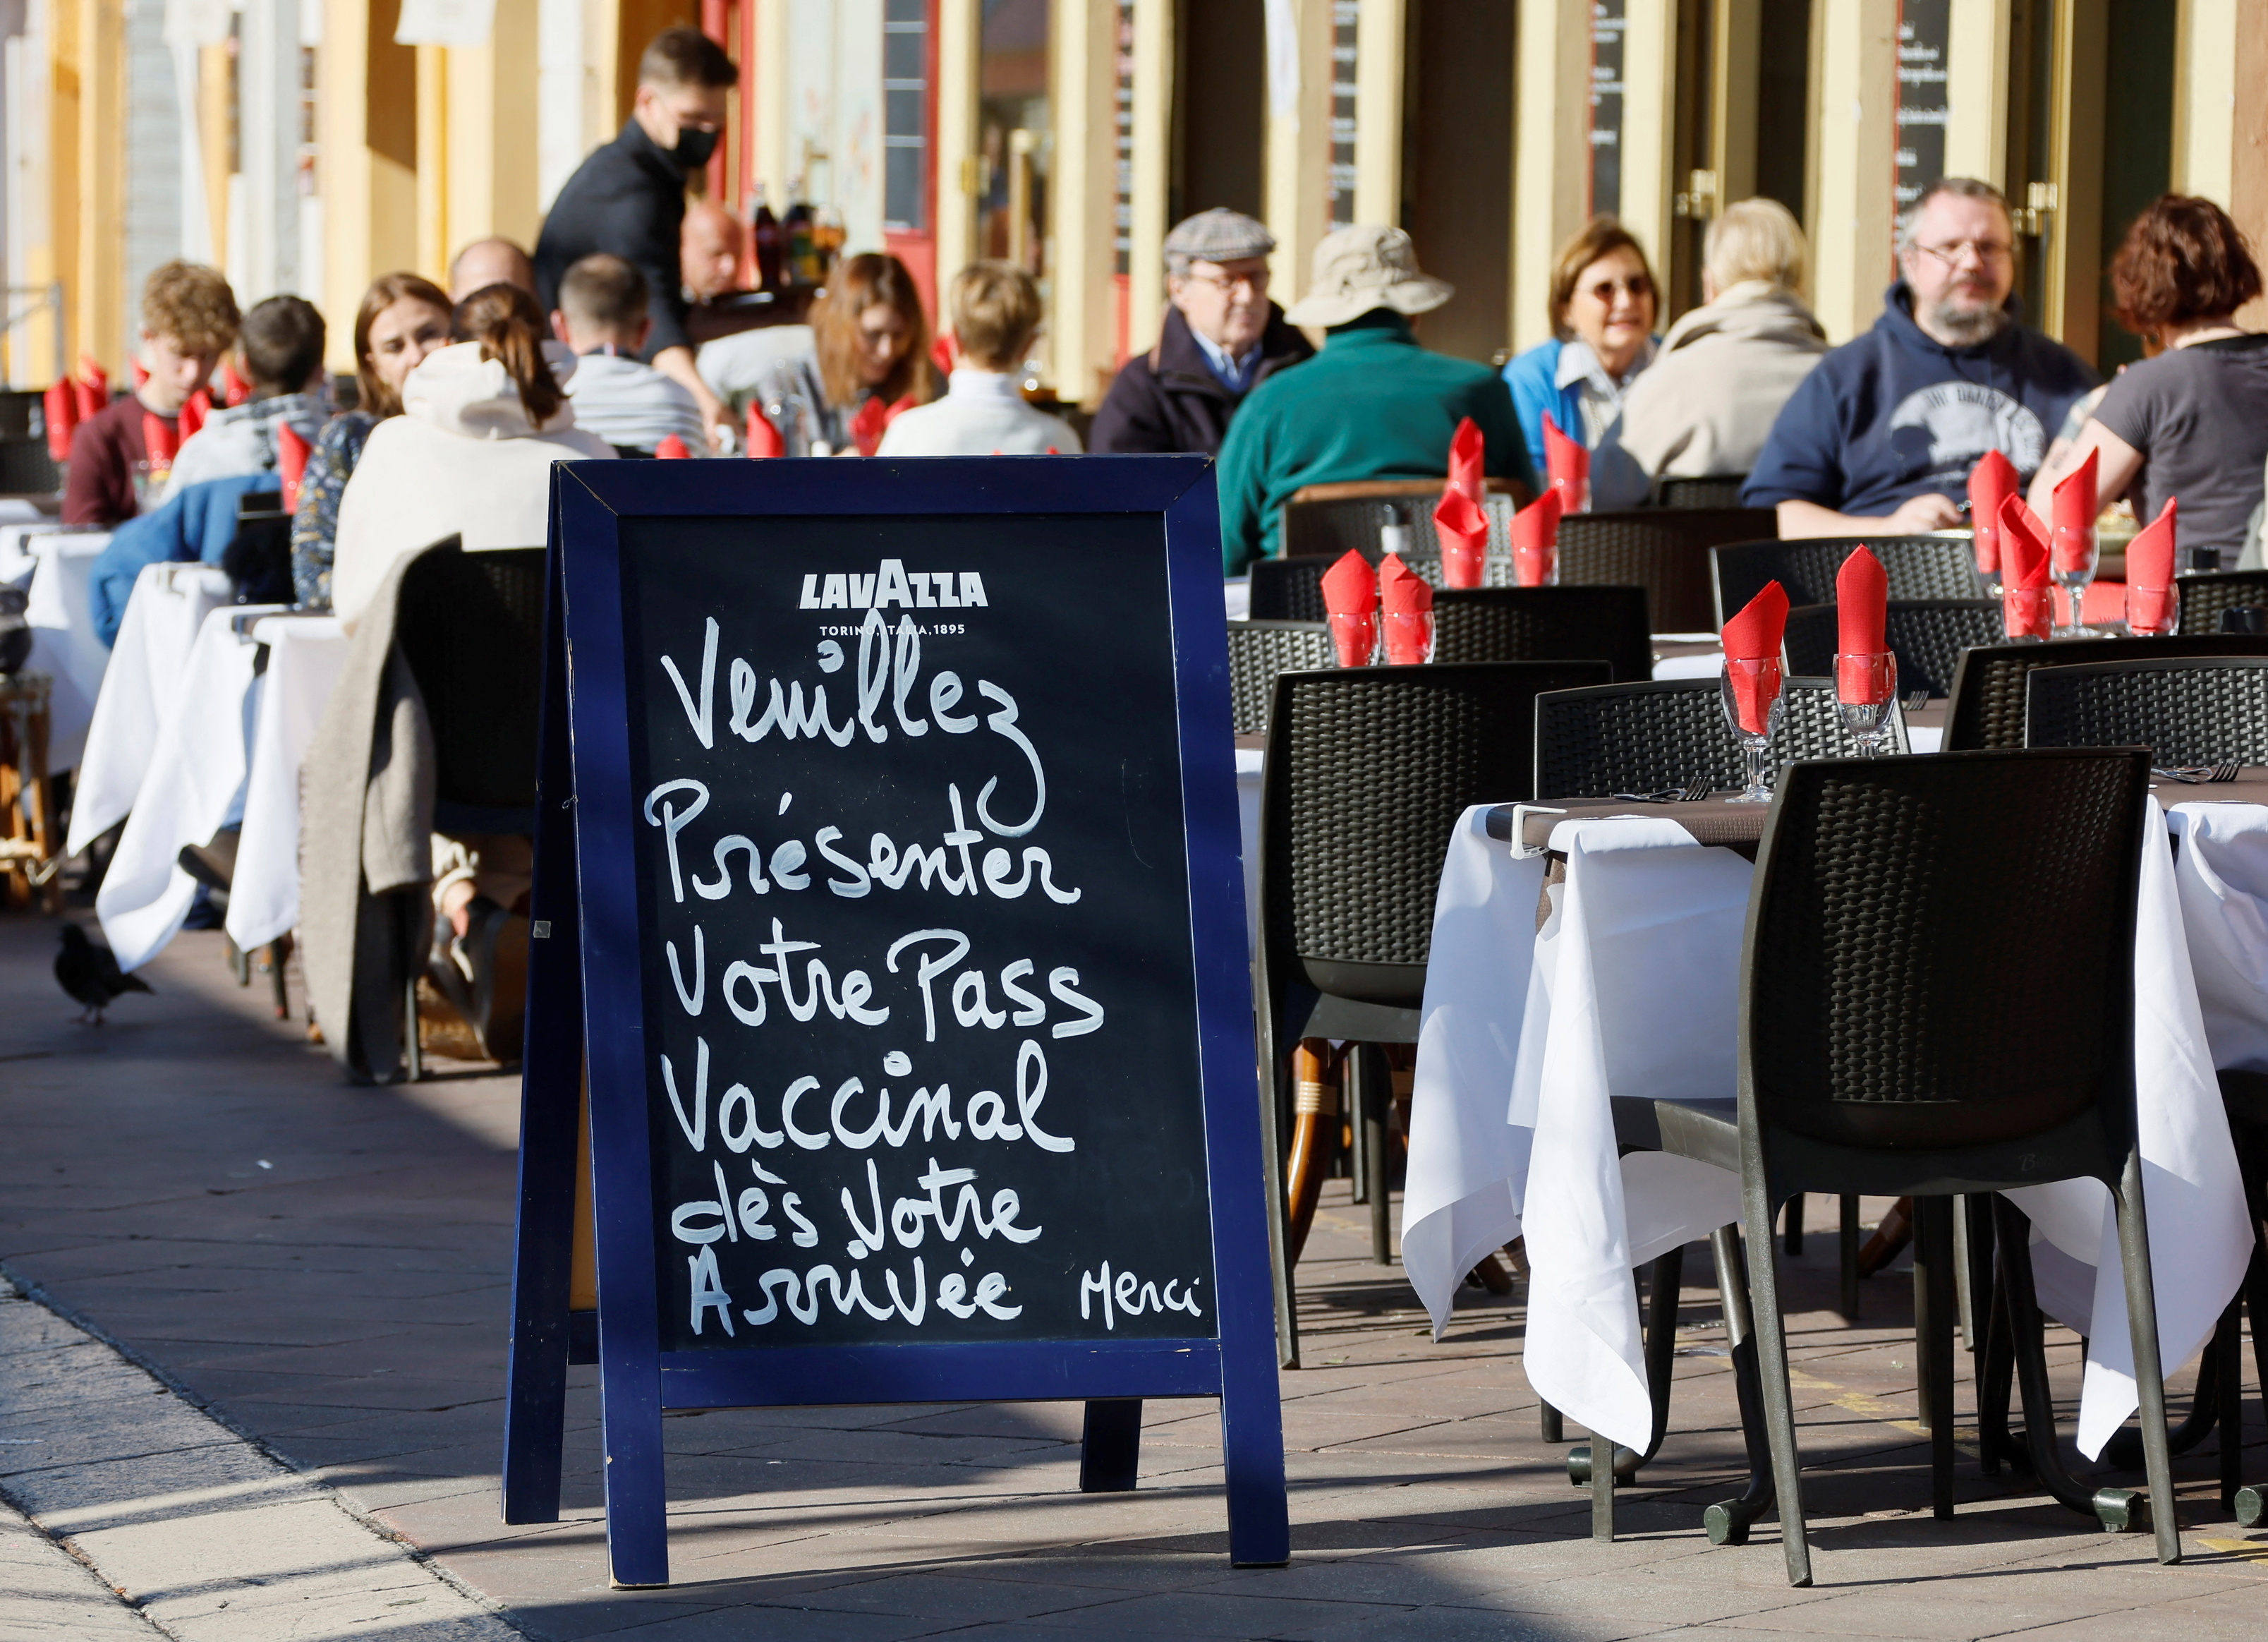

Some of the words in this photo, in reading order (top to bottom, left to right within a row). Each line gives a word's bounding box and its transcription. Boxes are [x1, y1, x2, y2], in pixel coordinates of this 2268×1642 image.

[799, 558, 989, 610] LAVAZZA
[933, 624, 966, 635] 1895
[660, 608, 1046, 838] Veuillez
[643, 778, 1082, 906] Présenter
[666, 917, 890, 1027] Votre
[886, 928, 1105, 1042] Pass
[660, 1036, 1077, 1154] Vaccinal
[671, 1157, 819, 1248] dès
[840, 1157, 1043, 1252] Votre
[687, 1240, 1024, 1338] Arrivée
[1080, 1260, 1203, 1332] Merci
